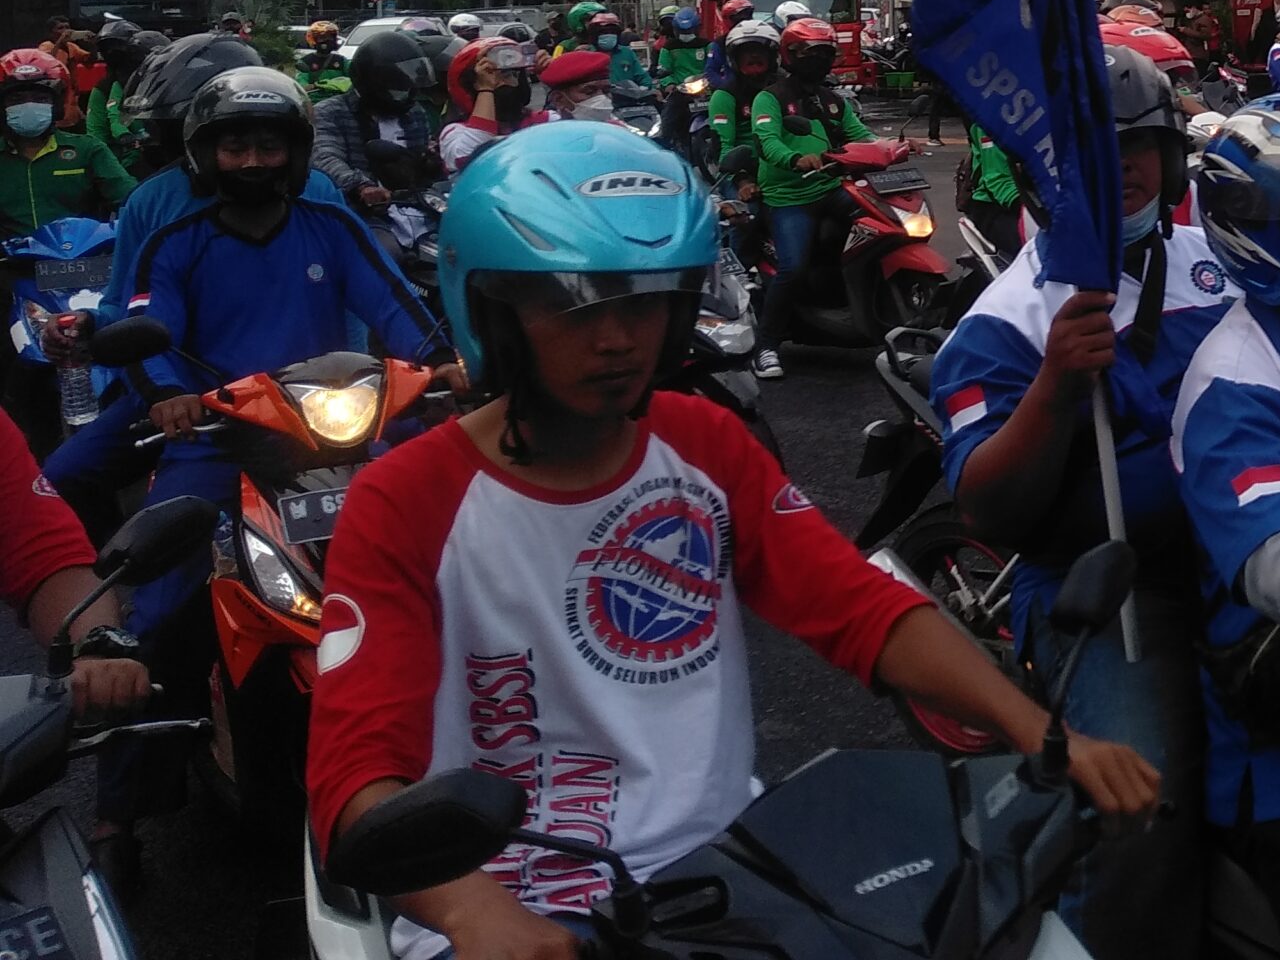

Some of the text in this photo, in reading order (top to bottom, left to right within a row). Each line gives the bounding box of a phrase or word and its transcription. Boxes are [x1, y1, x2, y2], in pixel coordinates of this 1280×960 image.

[965, 50, 1046, 137] SPSI
[589, 176, 672, 193] INK
[564, 586, 722, 686] SERIKAT BURUH SELURUH INDON
[466, 647, 542, 751] SBSI
[854, 858, 935, 895] HONDA
